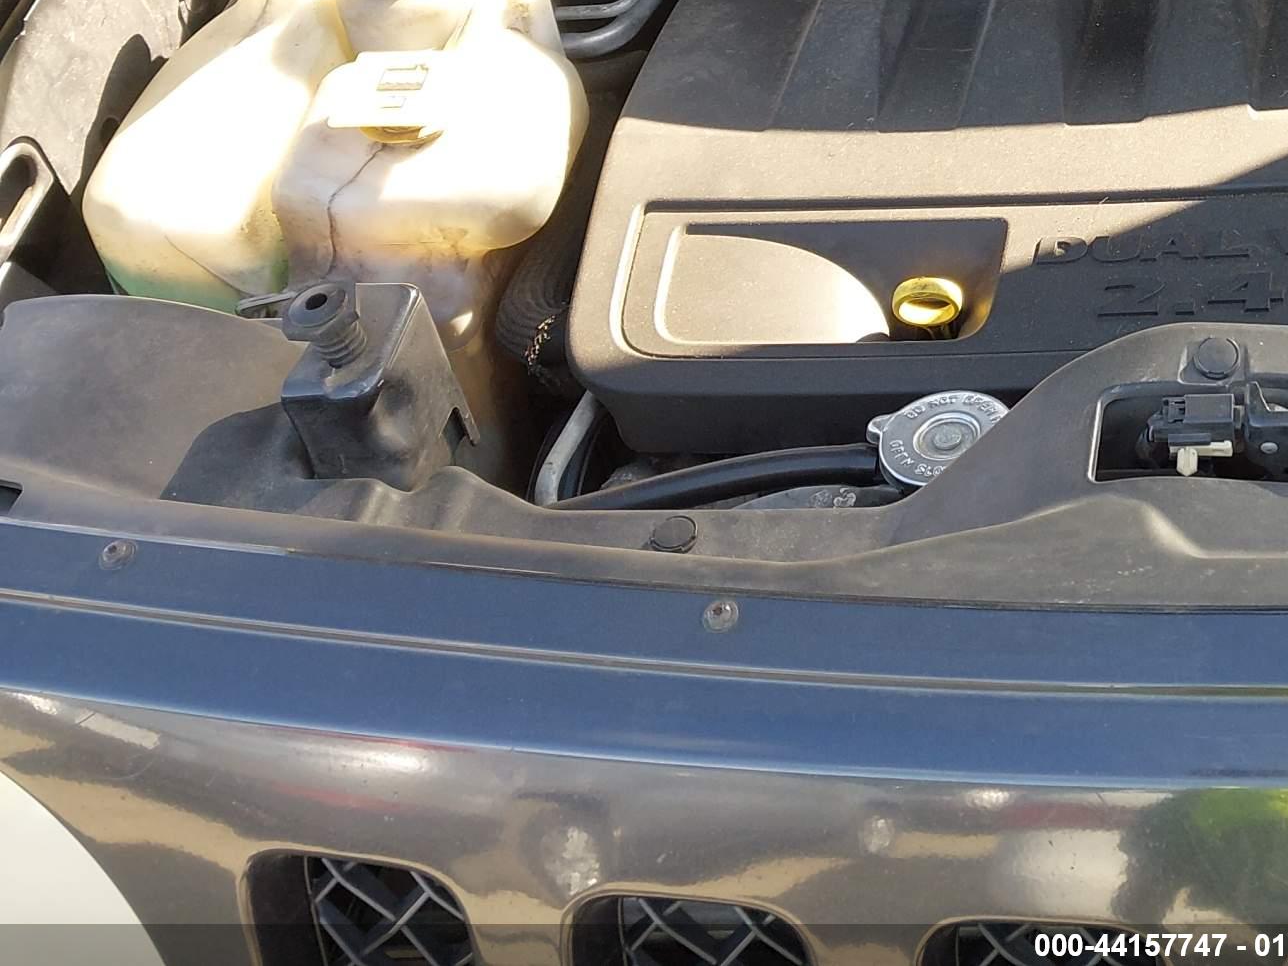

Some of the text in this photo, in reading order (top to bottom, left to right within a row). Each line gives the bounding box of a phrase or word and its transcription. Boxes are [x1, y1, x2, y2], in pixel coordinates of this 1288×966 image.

[1031, 230, 1250, 265] DUAL
[903, 394, 998, 419] DO NOT OPEN
